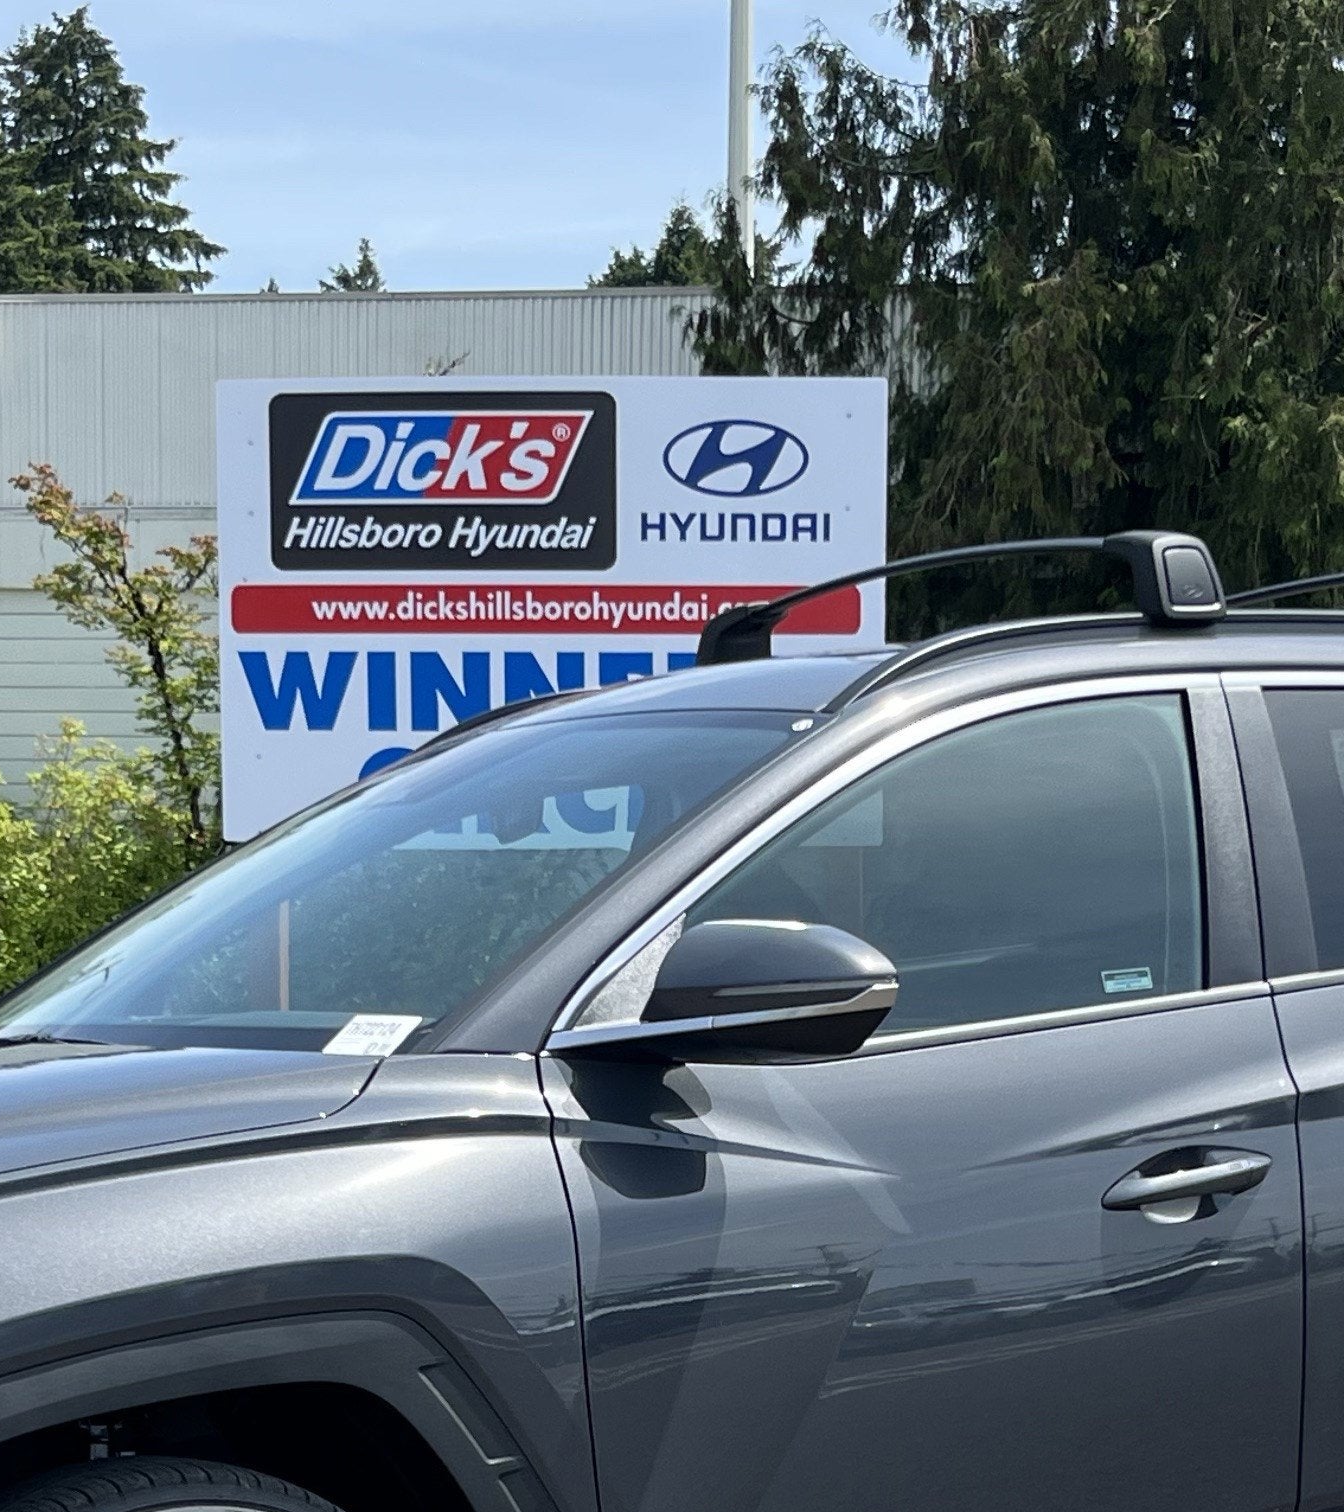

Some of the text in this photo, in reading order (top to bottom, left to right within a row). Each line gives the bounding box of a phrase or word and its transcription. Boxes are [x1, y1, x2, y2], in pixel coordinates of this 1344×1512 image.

[283, 516, 597, 557] Hillsboro Hyundai
[640, 512, 831, 542] HYUNDAI
[311, 591, 769, 629] www.dickshillsborohyundai.
[238, 651, 699, 732] WINN
